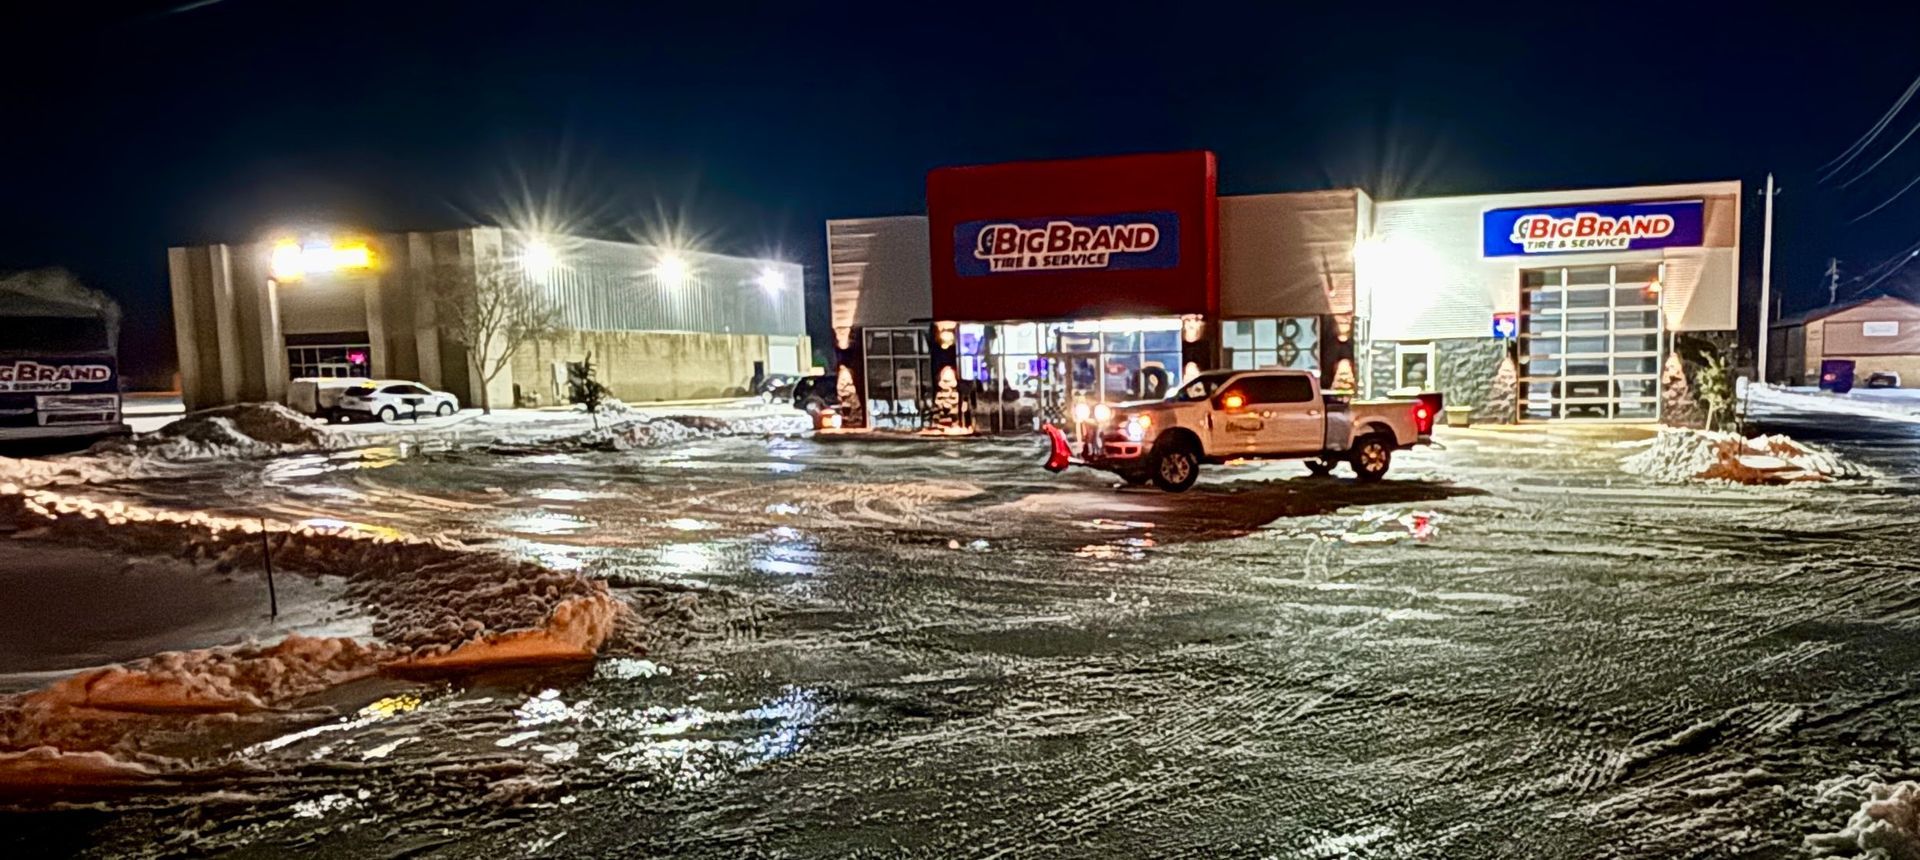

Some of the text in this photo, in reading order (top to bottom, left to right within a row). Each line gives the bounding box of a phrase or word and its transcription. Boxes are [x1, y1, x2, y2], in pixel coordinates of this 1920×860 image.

[1527, 237, 1626, 249] TIRE & SERVICE
[993, 253, 1106, 269] TIRE & SERVICE
